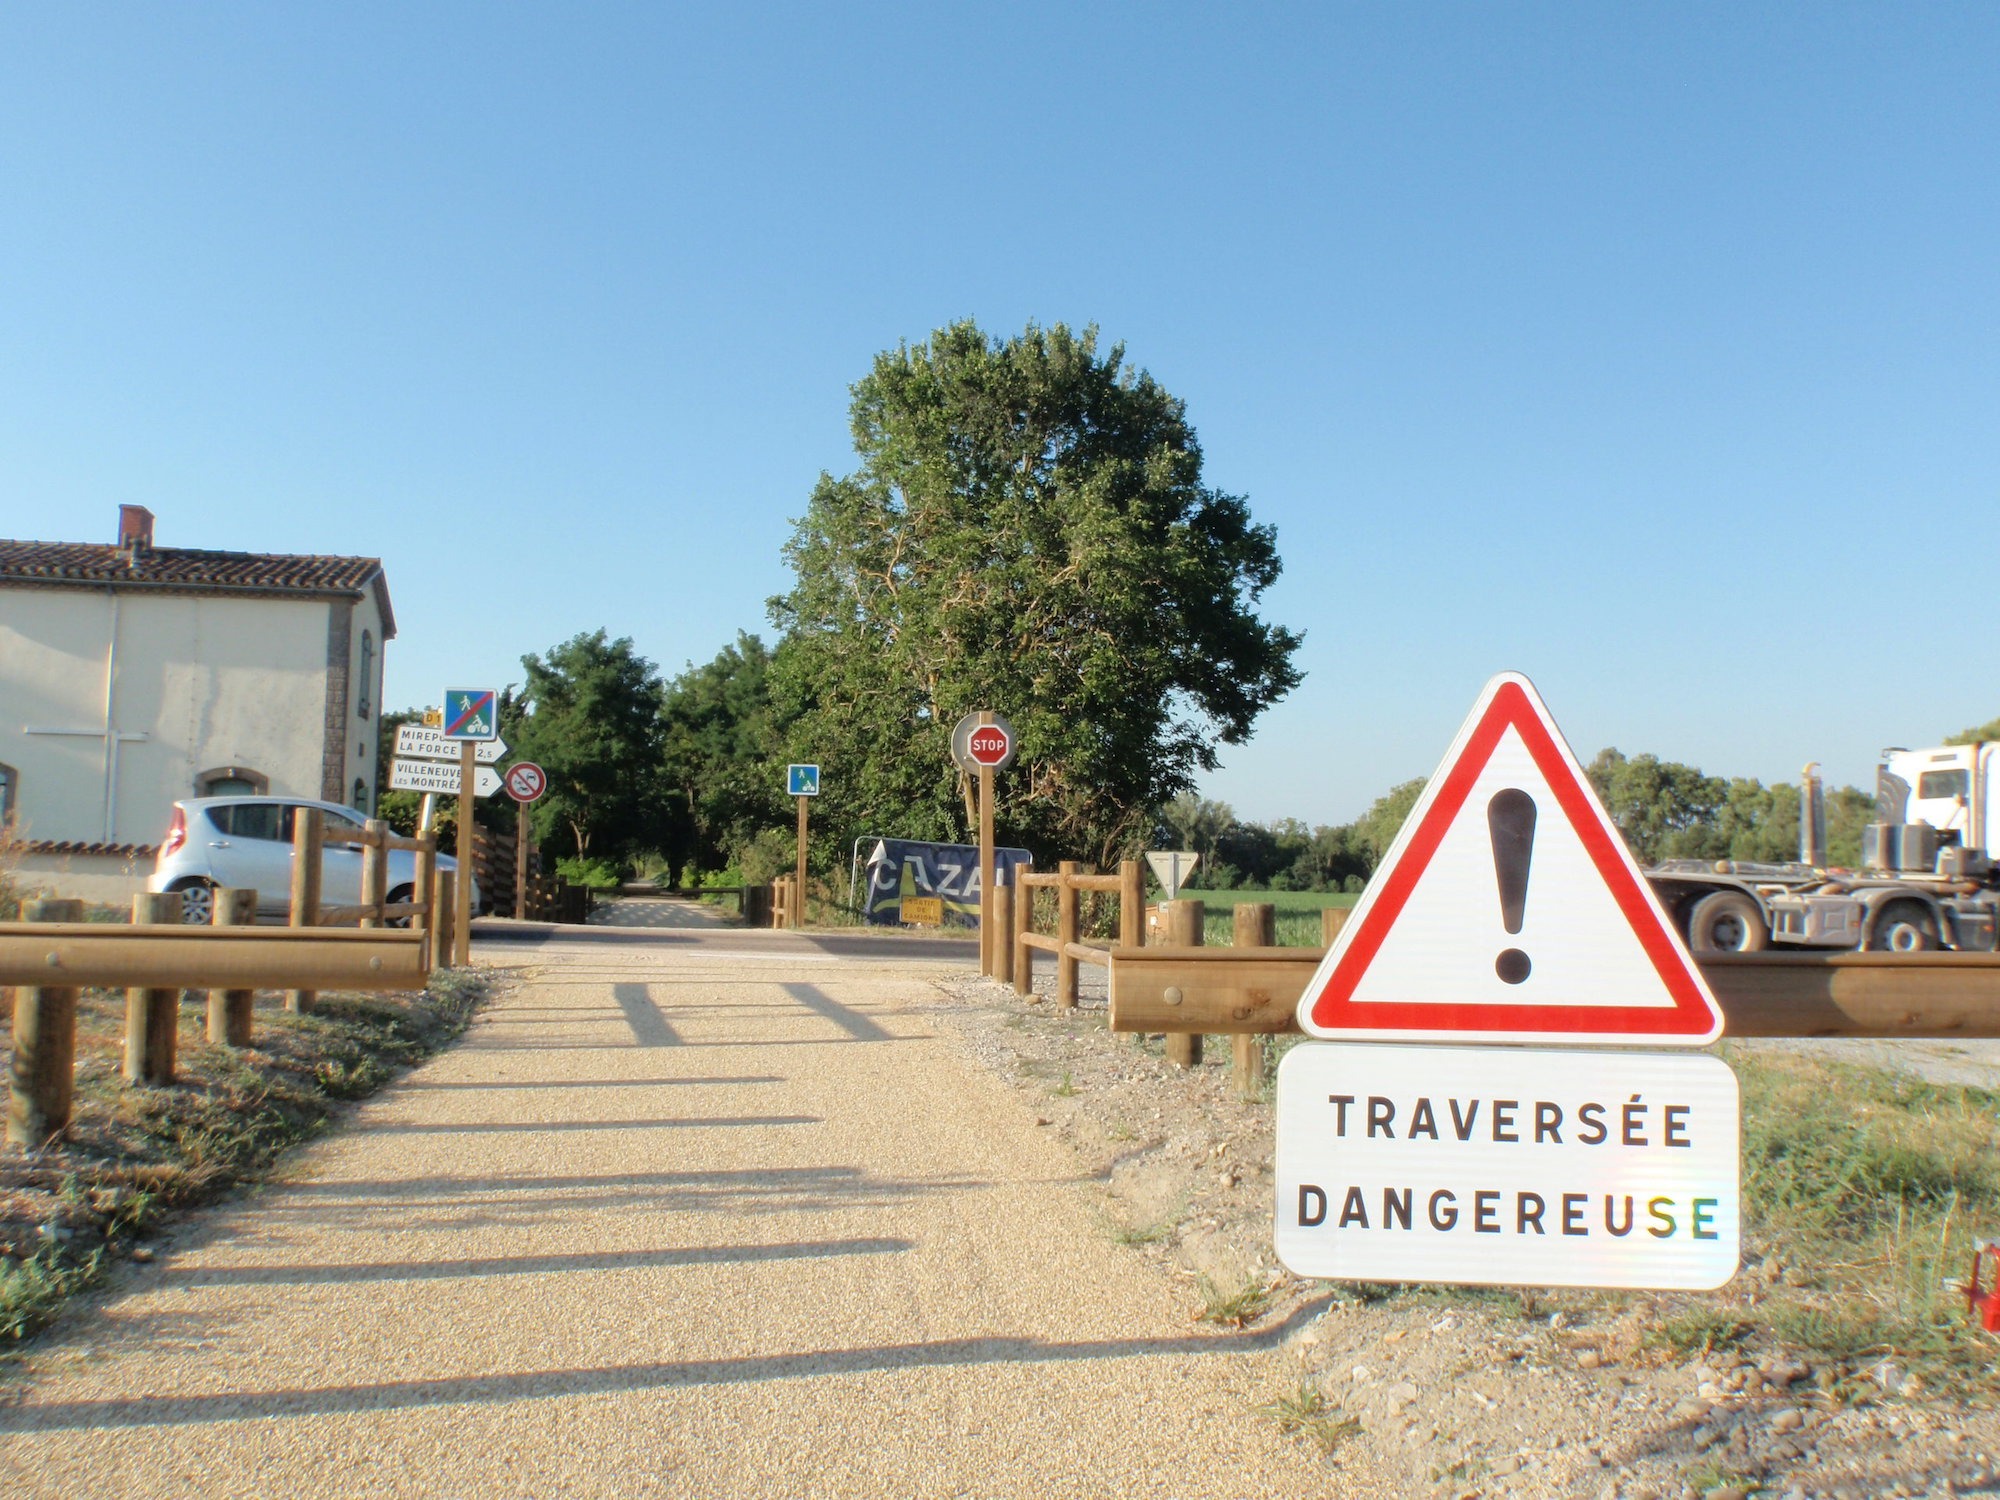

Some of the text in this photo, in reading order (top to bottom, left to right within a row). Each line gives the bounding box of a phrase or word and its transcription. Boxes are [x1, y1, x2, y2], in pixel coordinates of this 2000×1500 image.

[400, 742, 413, 751] LA
[418, 743, 457, 755] FORCE
[973, 740, 1004, 751] STOP
[481, 778, 489, 787] 2
[1328, 1094, 1691, 1148] TRAVERSÉE
[1298, 1184, 1719, 1241] DANGEREUSE
